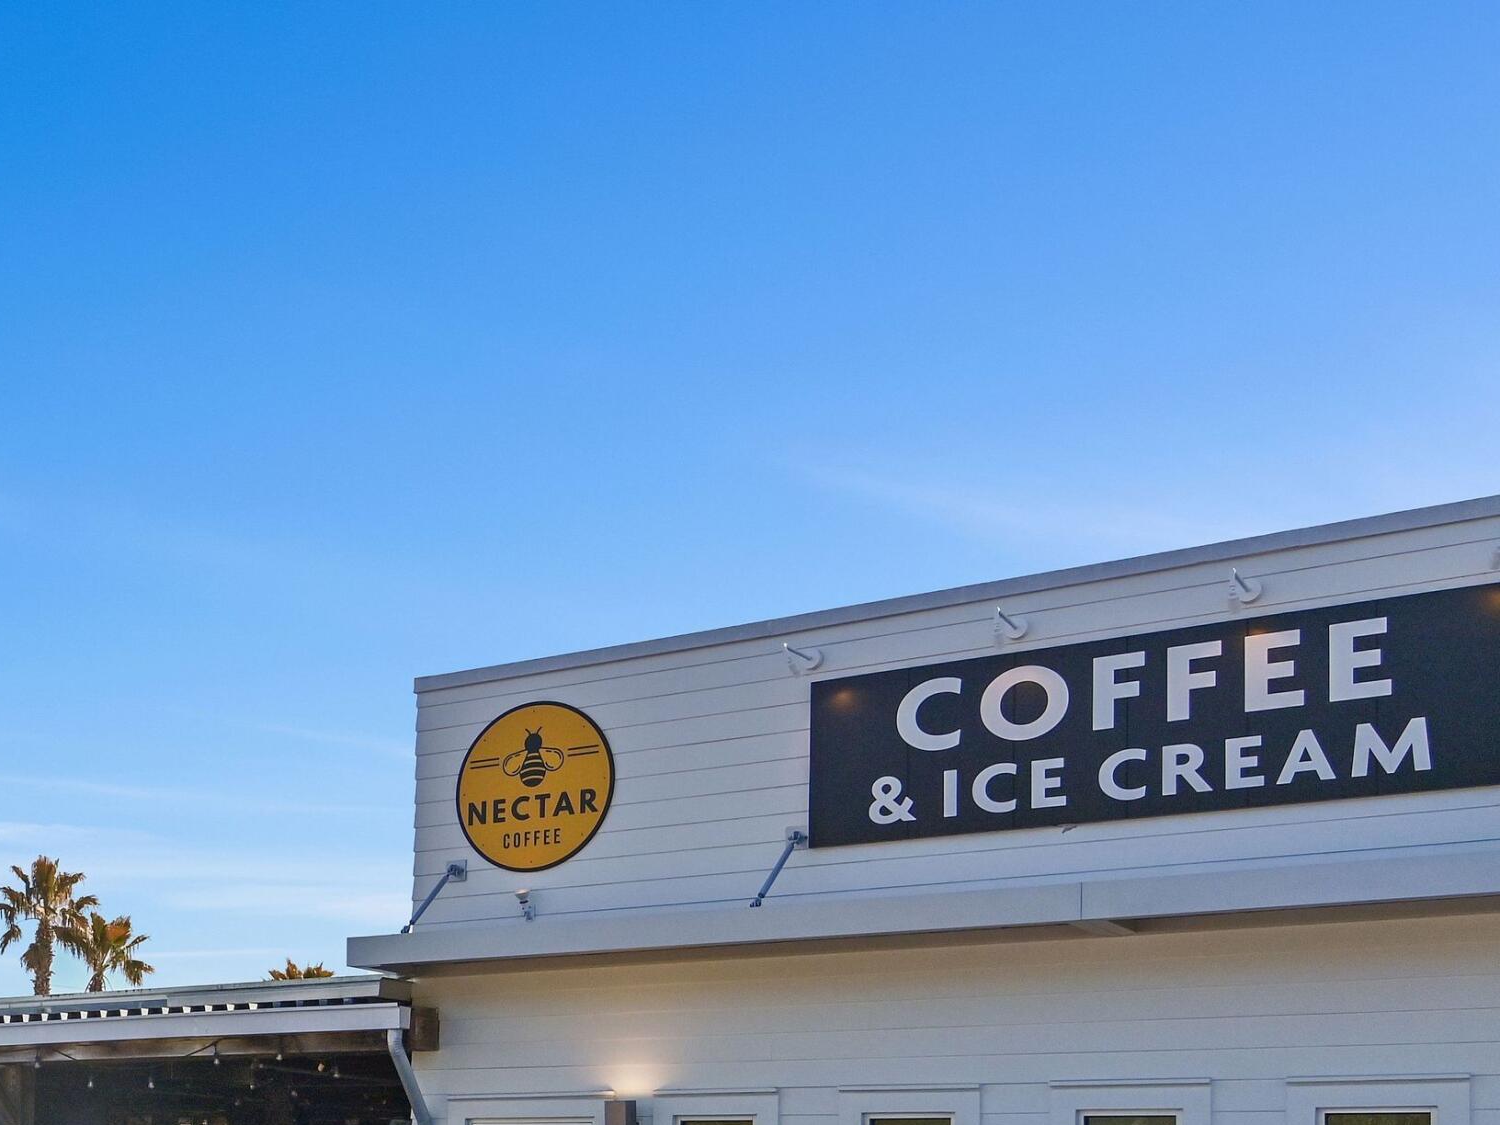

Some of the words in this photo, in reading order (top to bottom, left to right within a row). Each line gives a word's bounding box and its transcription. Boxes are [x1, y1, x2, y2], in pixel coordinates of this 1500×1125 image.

[896, 616, 1393, 751] COFFEE
[467, 788, 598, 826] NECTAR
[868, 775, 917, 825] &
[943, 757, 1067, 818] ICE
[1098, 716, 1432, 801] CREAM
[503, 828, 561, 849] COFFEE
